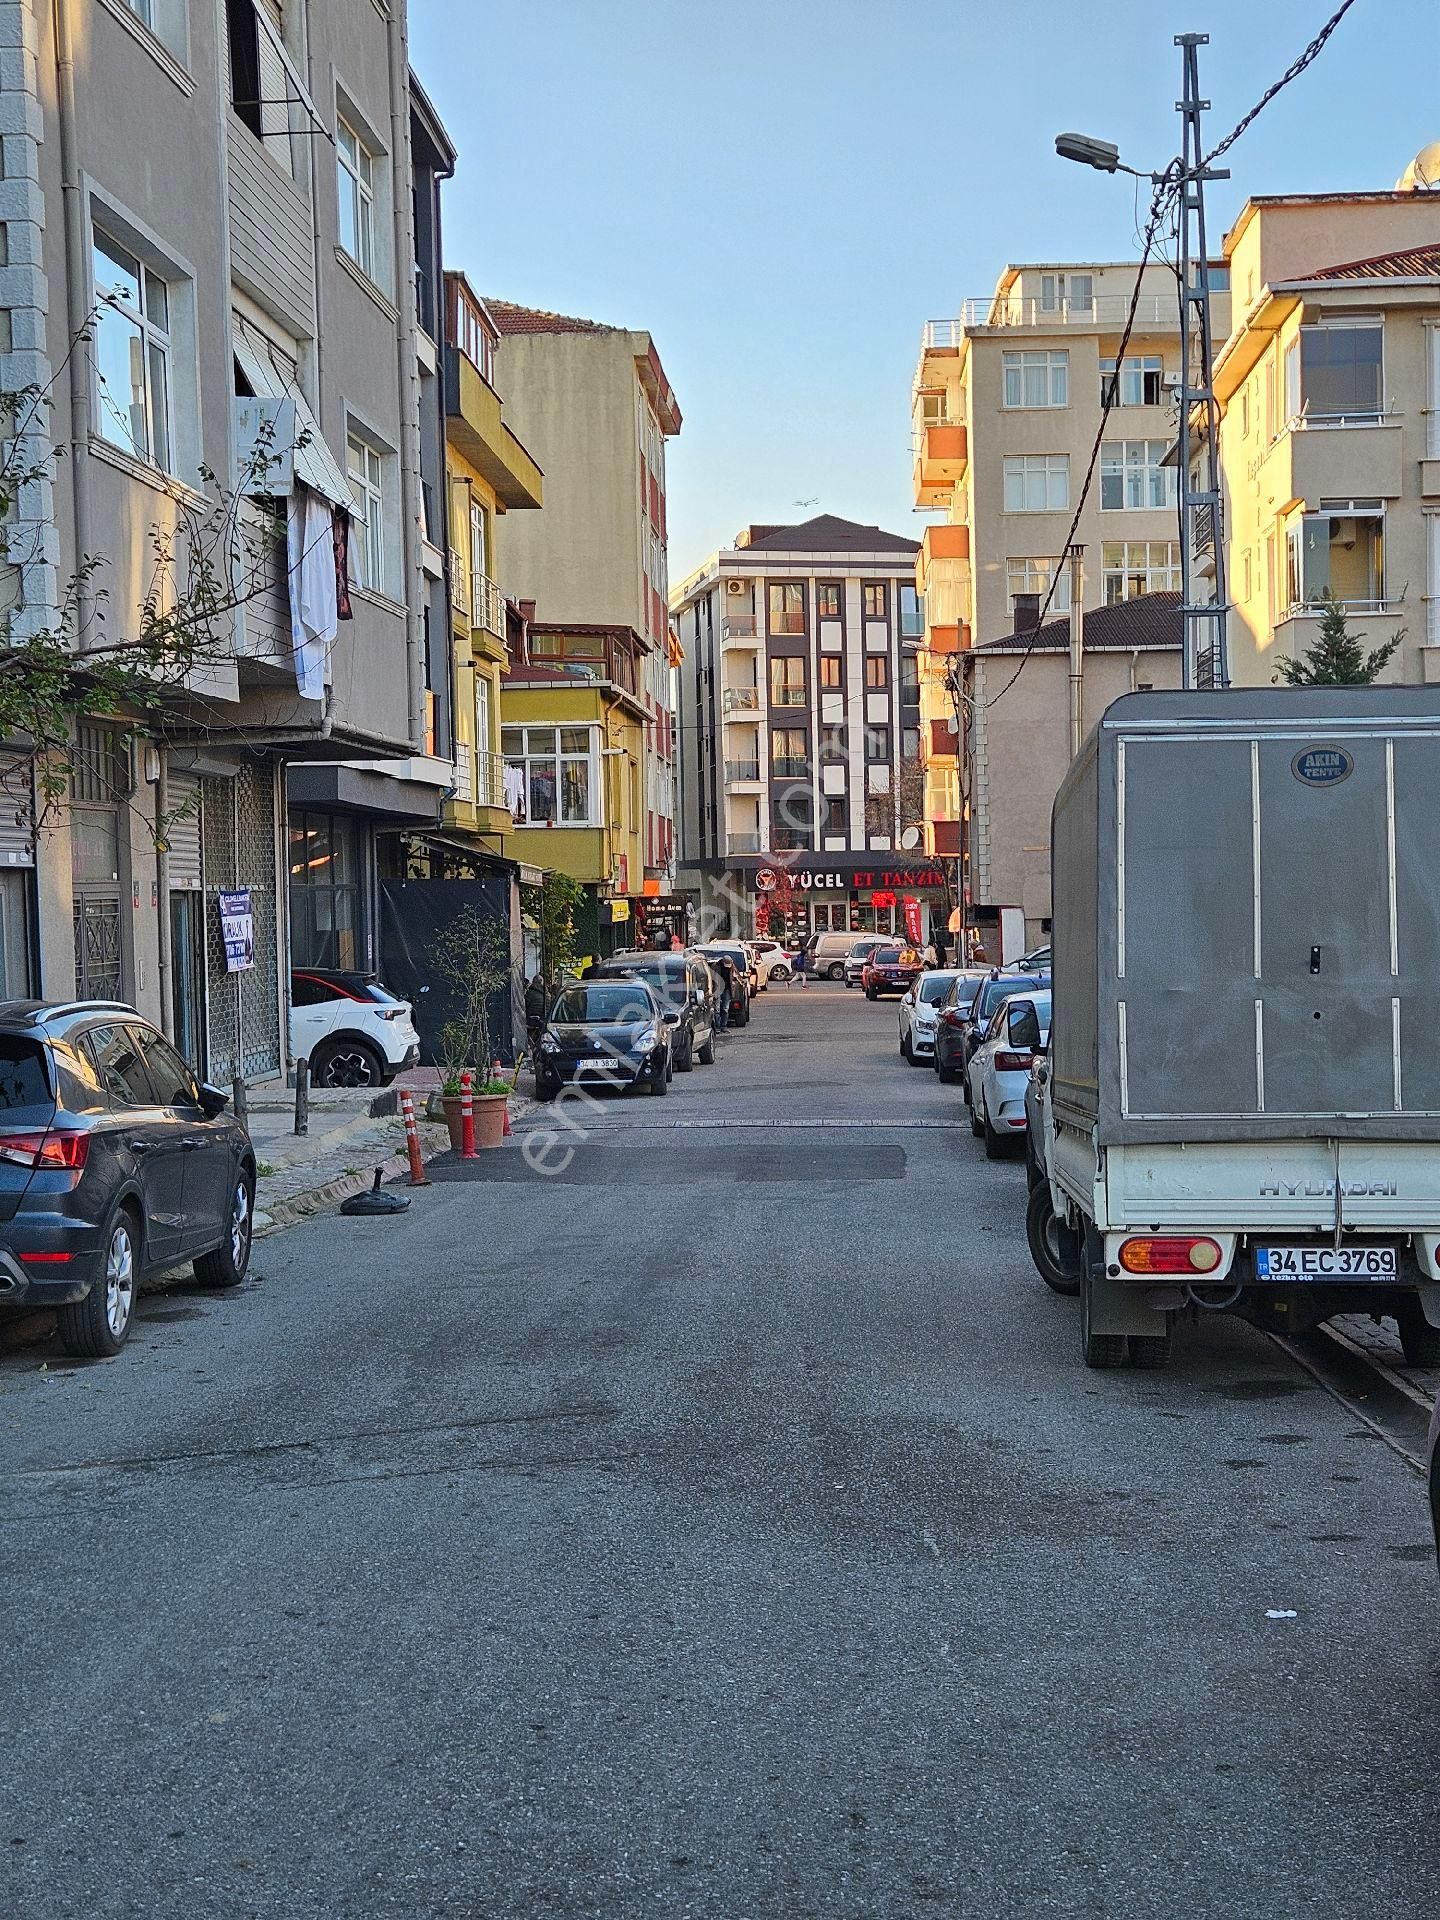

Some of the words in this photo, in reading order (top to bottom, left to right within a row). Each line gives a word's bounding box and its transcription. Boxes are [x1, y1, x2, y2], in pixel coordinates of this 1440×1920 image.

[1305, 753, 1340, 767] AKIN
[1304, 767, 1342, 777] TENTE
[788, 870, 844, 888] YÜCEL
[853, 871, 875, 888] ET
[1259, 1179, 1397, 1196] HYUNDAI
[1269, 1250, 1297, 1273] 34
[1301, 1250, 1334, 1273] EC
[1338, 1250, 1394, 1273] 3769
